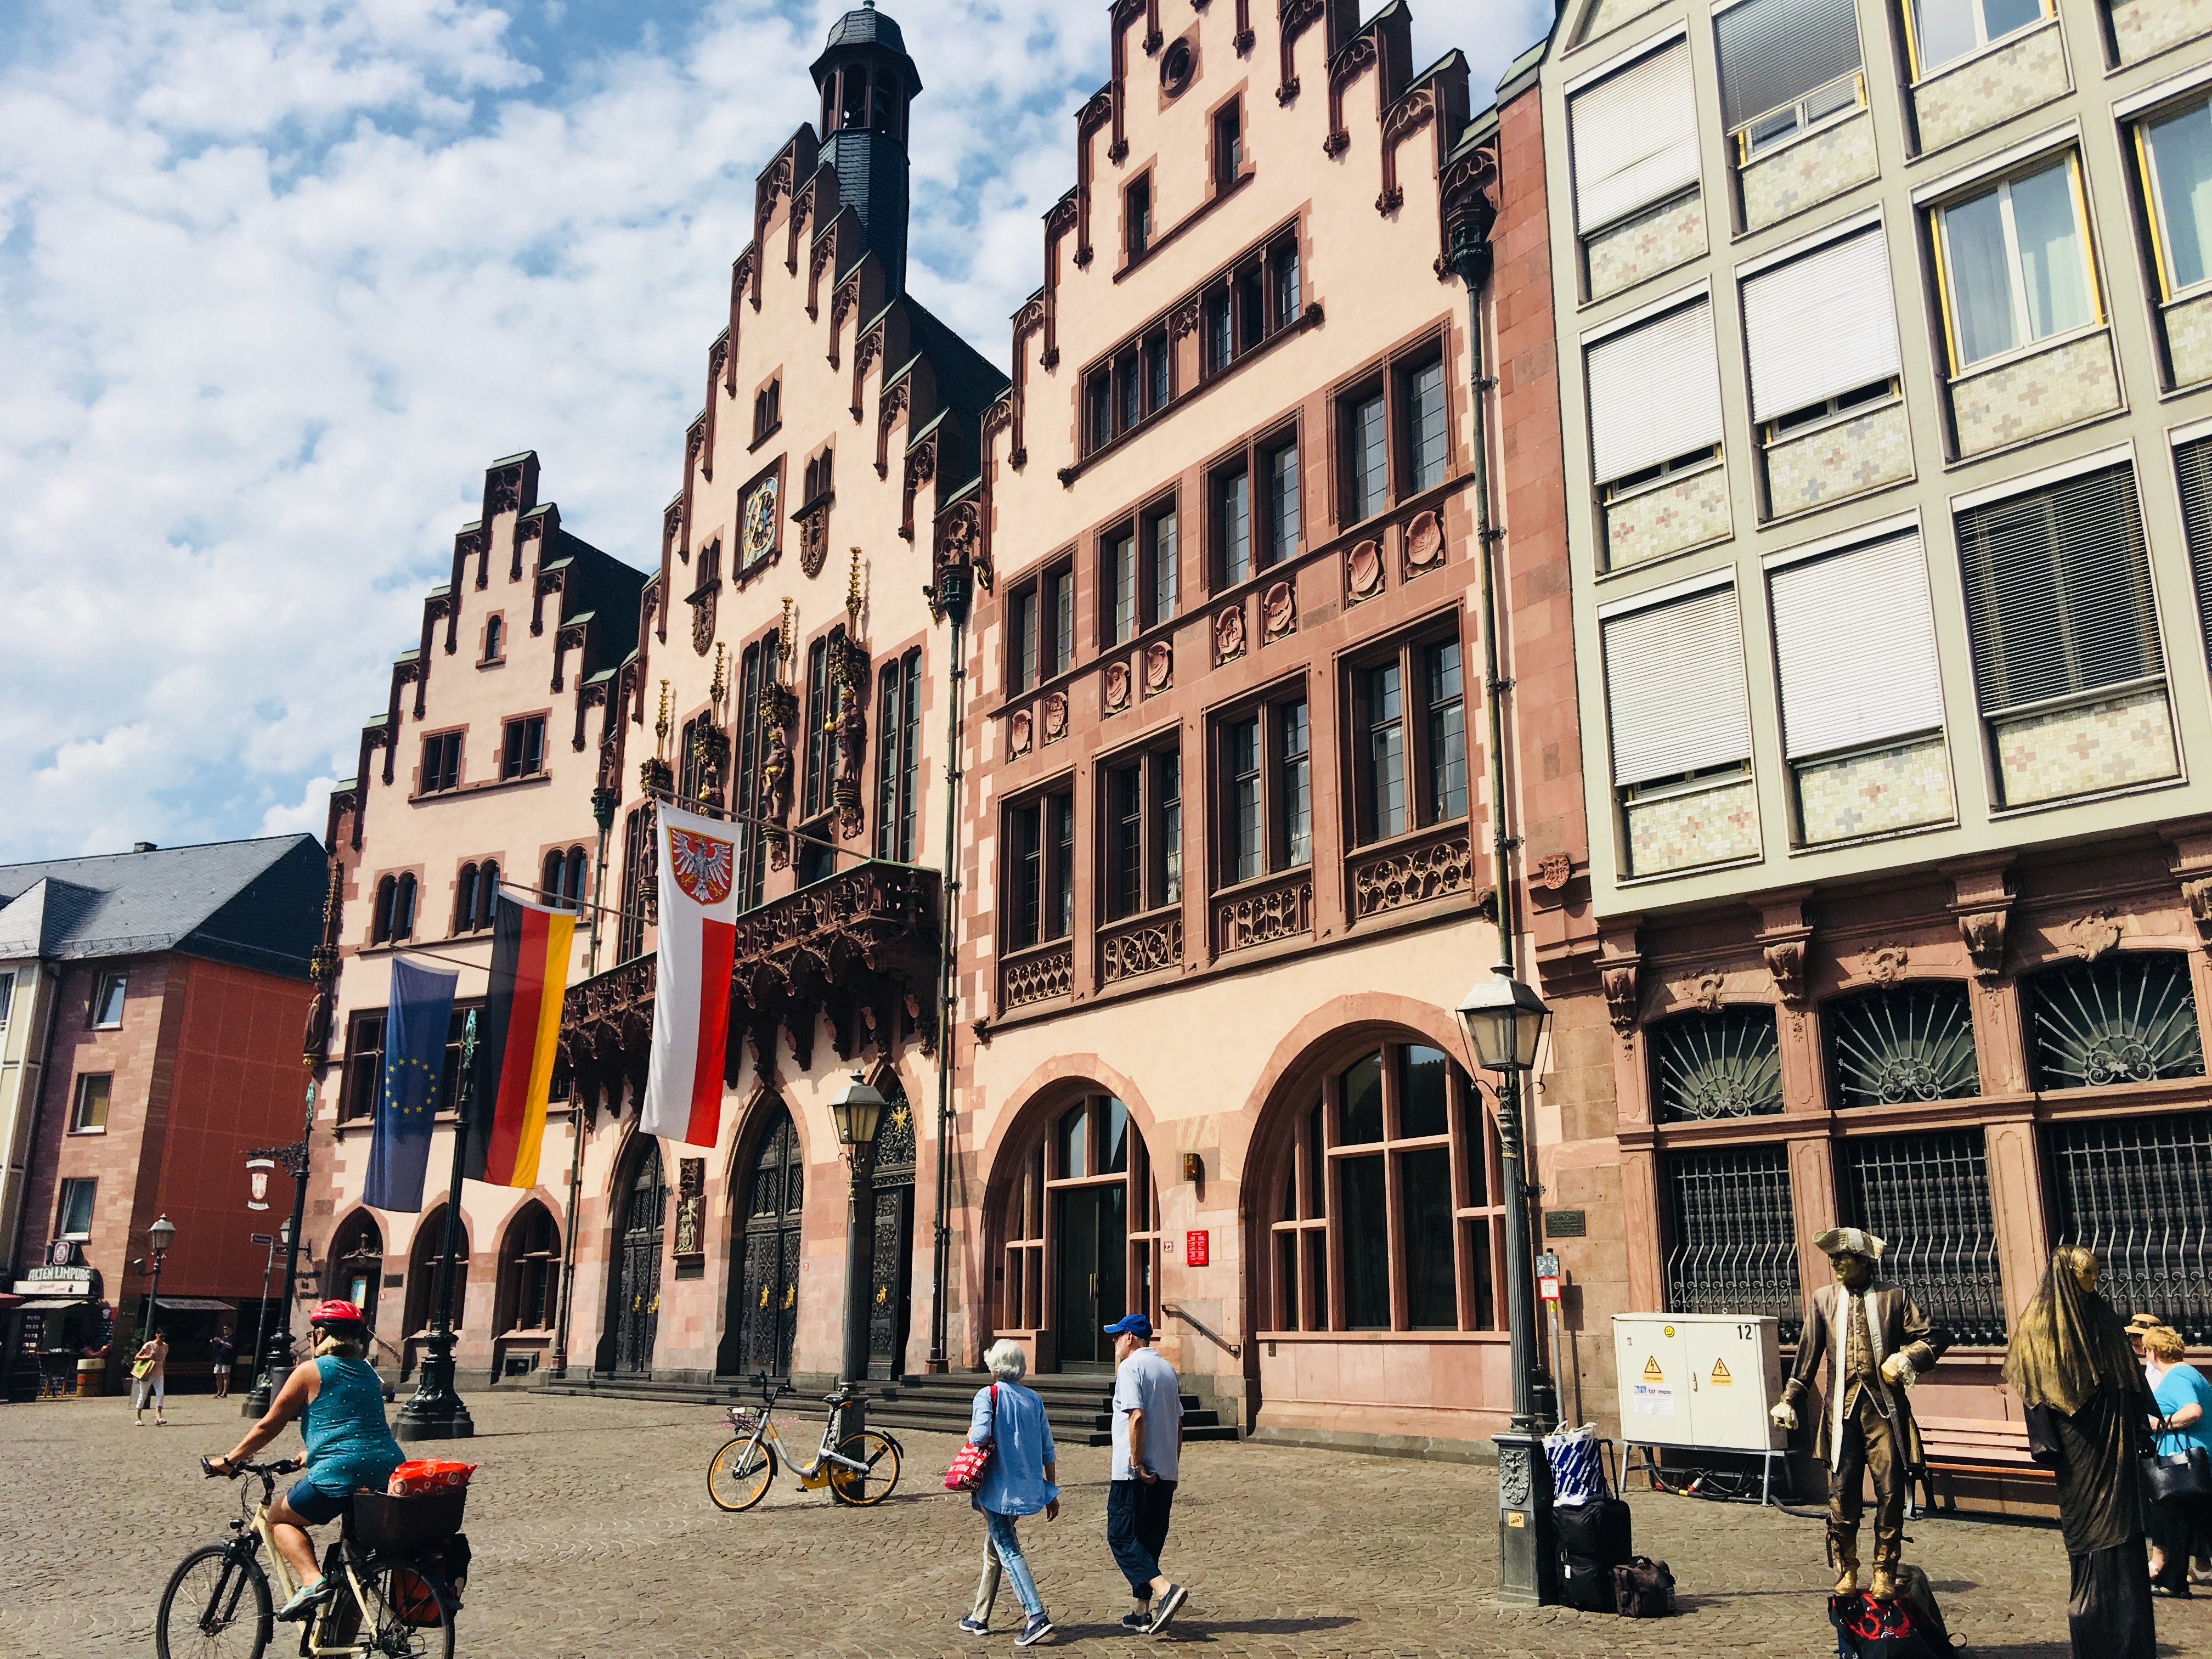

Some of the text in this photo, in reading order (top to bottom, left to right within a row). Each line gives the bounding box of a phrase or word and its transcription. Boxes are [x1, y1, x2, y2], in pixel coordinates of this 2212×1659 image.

[1165, 1242, 1172, 1251] 23
[27, 1267, 54, 1281] ALTEN
[1737, 1324, 1752, 1340] 12
